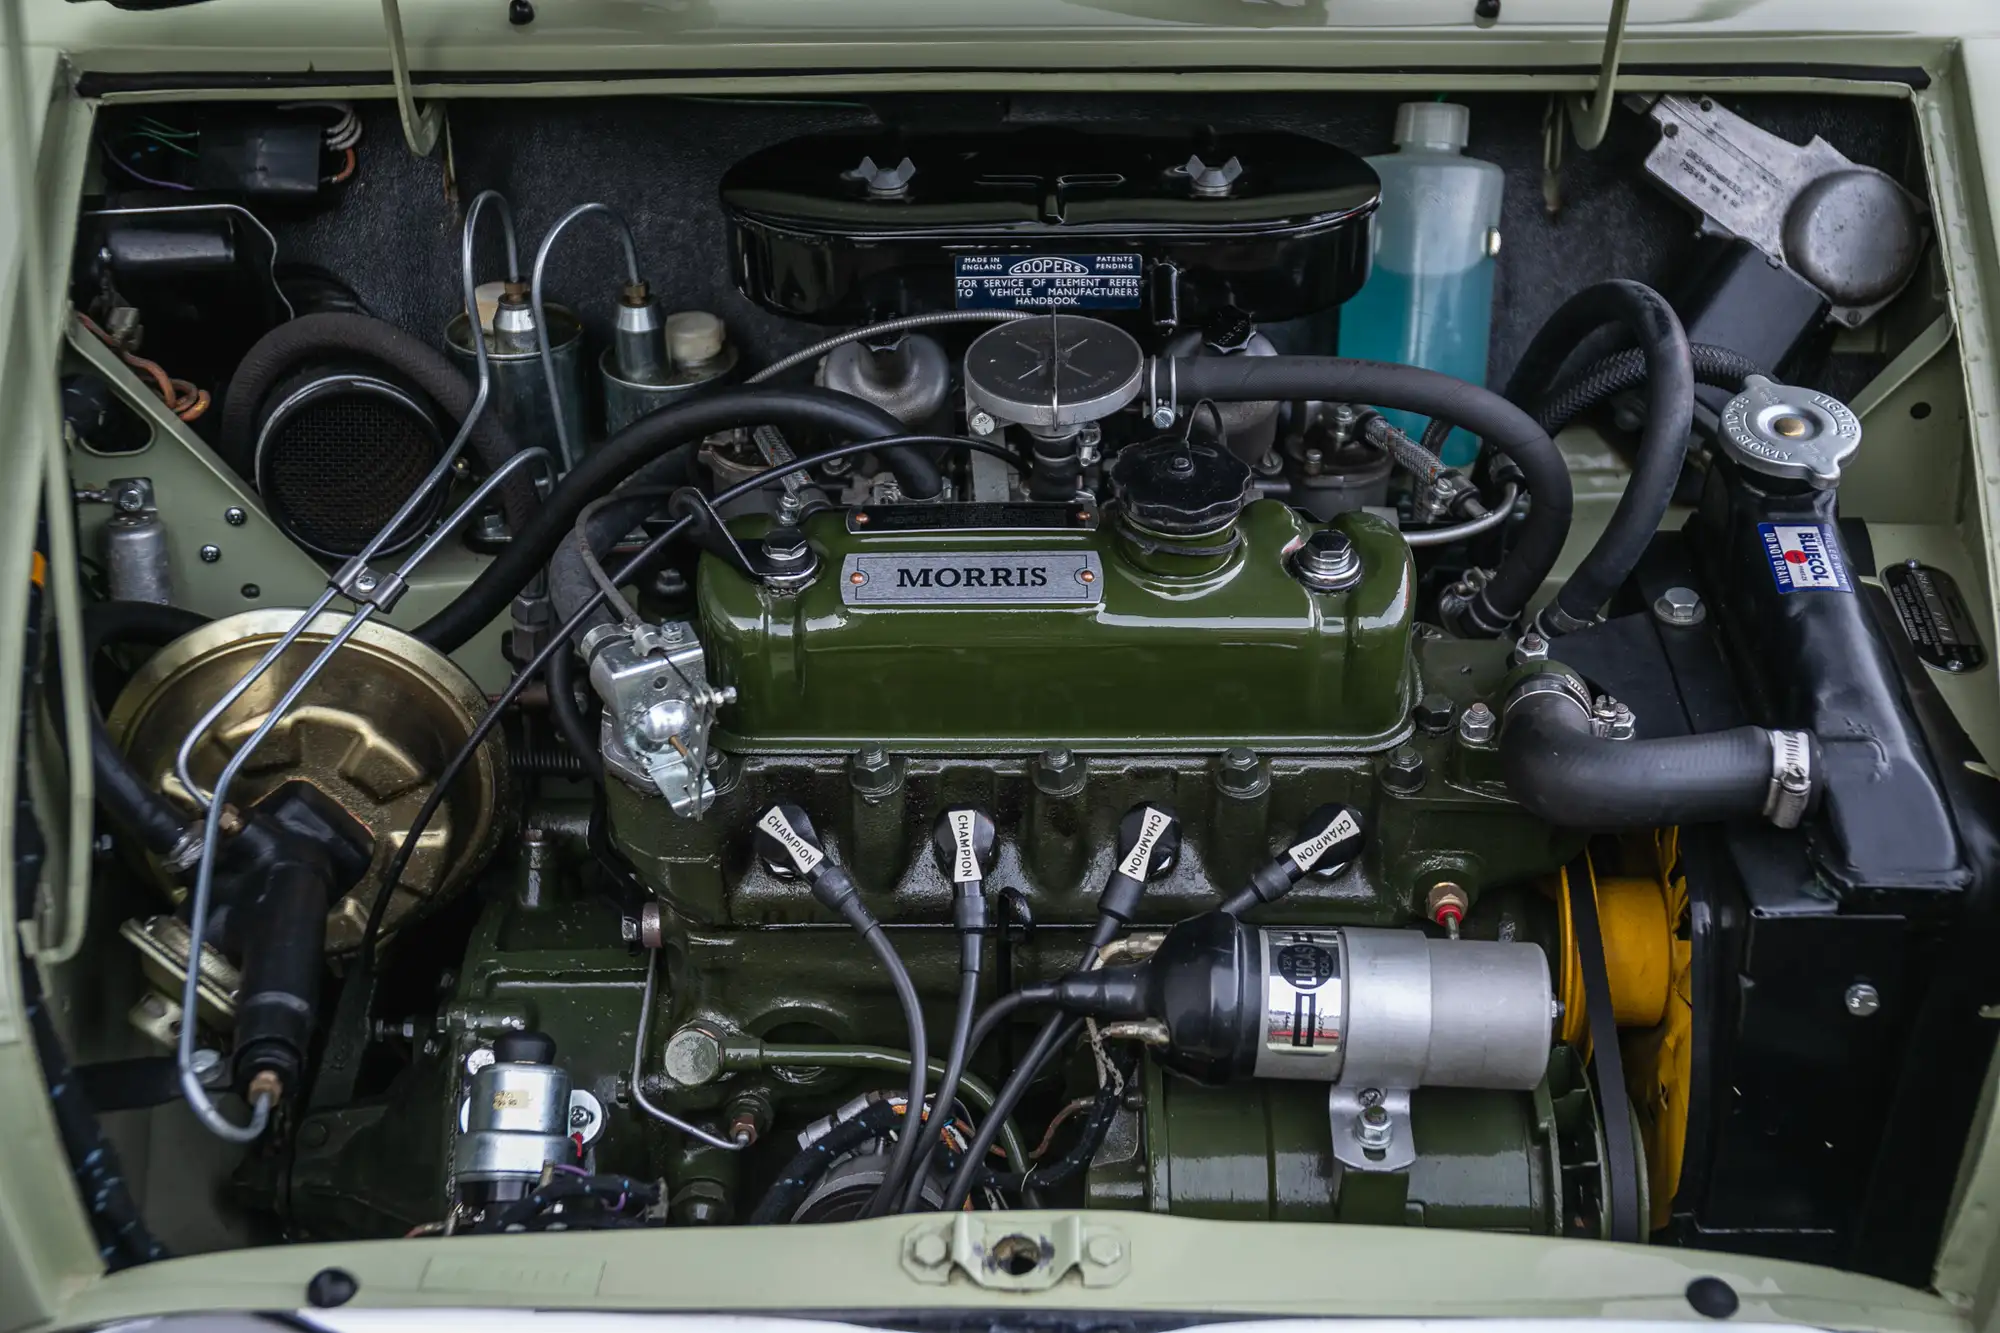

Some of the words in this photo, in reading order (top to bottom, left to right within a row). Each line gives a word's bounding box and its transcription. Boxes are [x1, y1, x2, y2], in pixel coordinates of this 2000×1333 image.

[957, 279, 978, 288] FOR
[984, 279, 1024, 288] SERVICE
[1032, 278, 1046, 287] OF
[1055, 278, 1101, 287] ELEMENT
[1109, 278, 1138, 287] REFER
[957, 288, 974, 297] TO
[989, 288, 1032, 296] VEHICLE
[1047, 287, 1139, 296] MANUFACTURERS
[1015, 297, 1081, 305] HANDBOOK.
[1814, 393, 1857, 439] TIGHTEN
[1736, 434, 1792, 460] SLOWLY
[1764, 532, 1777, 542] DO
[1768, 544, 1783, 559] NOT
[1773, 560, 1791, 584] DRAIN
[1797, 532, 1829, 581] BLUECOL
[1823, 532, 1839, 560] FILLED
[1833, 561, 1848, 584] WITH
[896, 567, 1048, 588] MORRIS
[767, 815, 815, 866] CHAMPION
[957, 814, 972, 877] CHAMPION
[1128, 814, 1162, 875] CHAMPION
[1296, 819, 1351, 863] CHAMPION
[1295, 945, 1317, 986] LUCAS
